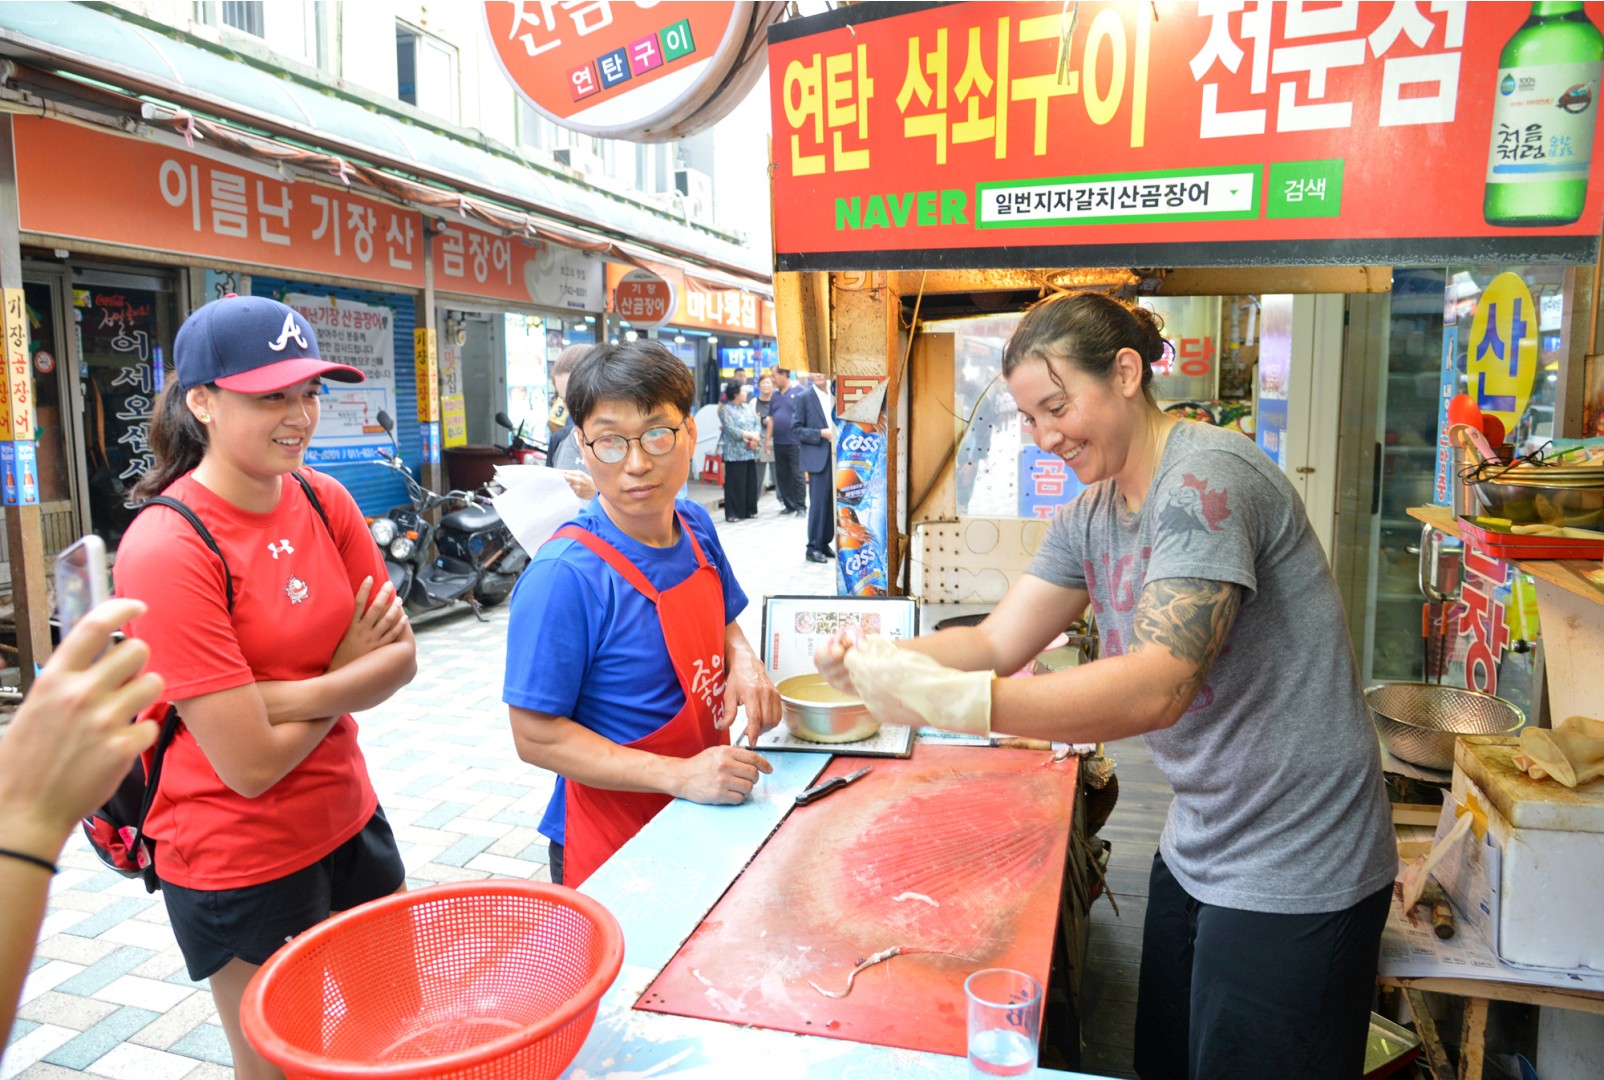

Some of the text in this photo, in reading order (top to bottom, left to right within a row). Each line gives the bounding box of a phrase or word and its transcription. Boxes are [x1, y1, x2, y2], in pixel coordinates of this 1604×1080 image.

[572, 25, 689, 95] 연탄구이
[783, 43, 874, 177] 연탄
[896, 5, 1153, 166] 석쇠구이
[1498, 122, 1543, 143] 처음
[1497, 144, 1546, 161] 처럼
[1283, 178, 1327, 202] 검색
[159, 159, 293, 246] 이름난
[442, 228, 512, 286] 곰장어
[835, 190, 969, 231] NAVER
[621, 297, 665, 316] 산곰장어
[631, 283, 656, 294] 기장
[268, 312, 308, 351] A
[1476, 297, 1527, 413] 산
